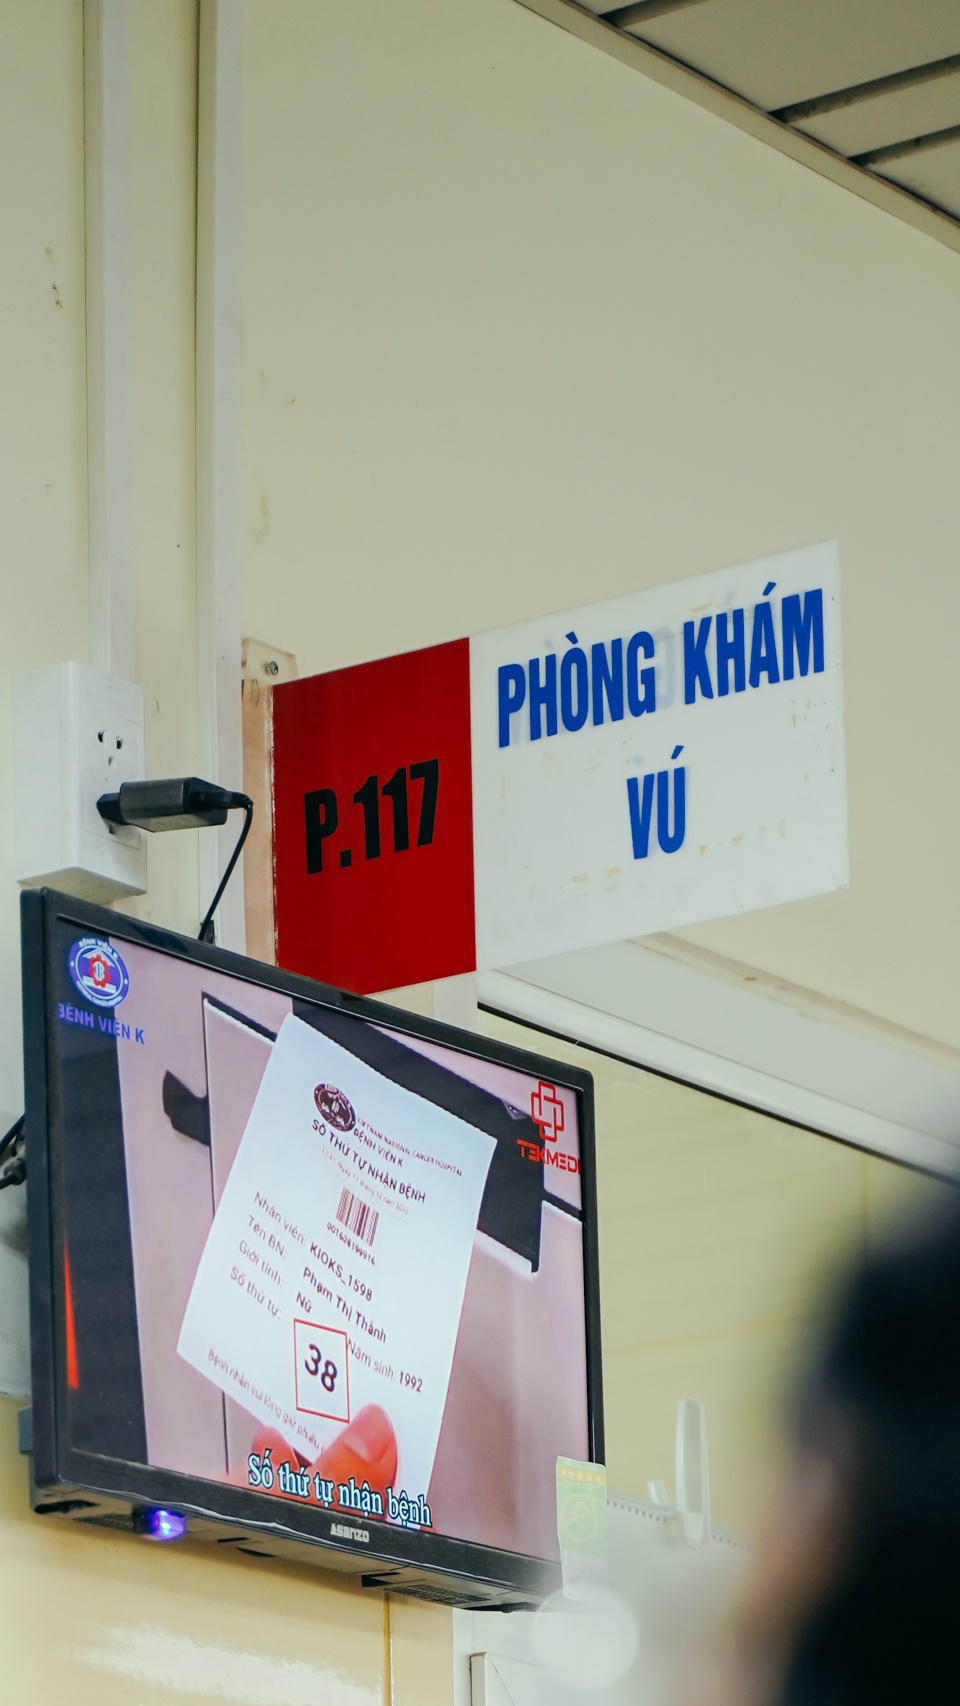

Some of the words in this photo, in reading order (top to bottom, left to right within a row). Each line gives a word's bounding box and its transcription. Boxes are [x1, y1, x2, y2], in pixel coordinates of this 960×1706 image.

[497, 631, 658, 749] PHÒNG
[683, 581, 826, 706] KHÁM
[304, 759, 440, 875] P.117
[626, 745, 688, 860] VÚ
[135, 1027, 145, 1045] K
[397, 1158, 404, 1168] K
[399, 1182, 426, 1203] BỆNH
[230, 1266, 246, 1287] Số
[303, 1266, 333, 1302] Phạm
[336, 1296, 353, 1322] Thị
[309, 1241, 373, 1302] KIOKS_1598
[304, 1343, 338, 1393] 38
[399, 1370, 424, 1394] 1992
[248, 1448, 274, 1488] Số
[277, 1460, 312, 1497] thứ
[314, 1474, 336, 1508] tự
[338, 1478, 384, 1518] nhận
[387, 1487, 432, 1528] bệnh
